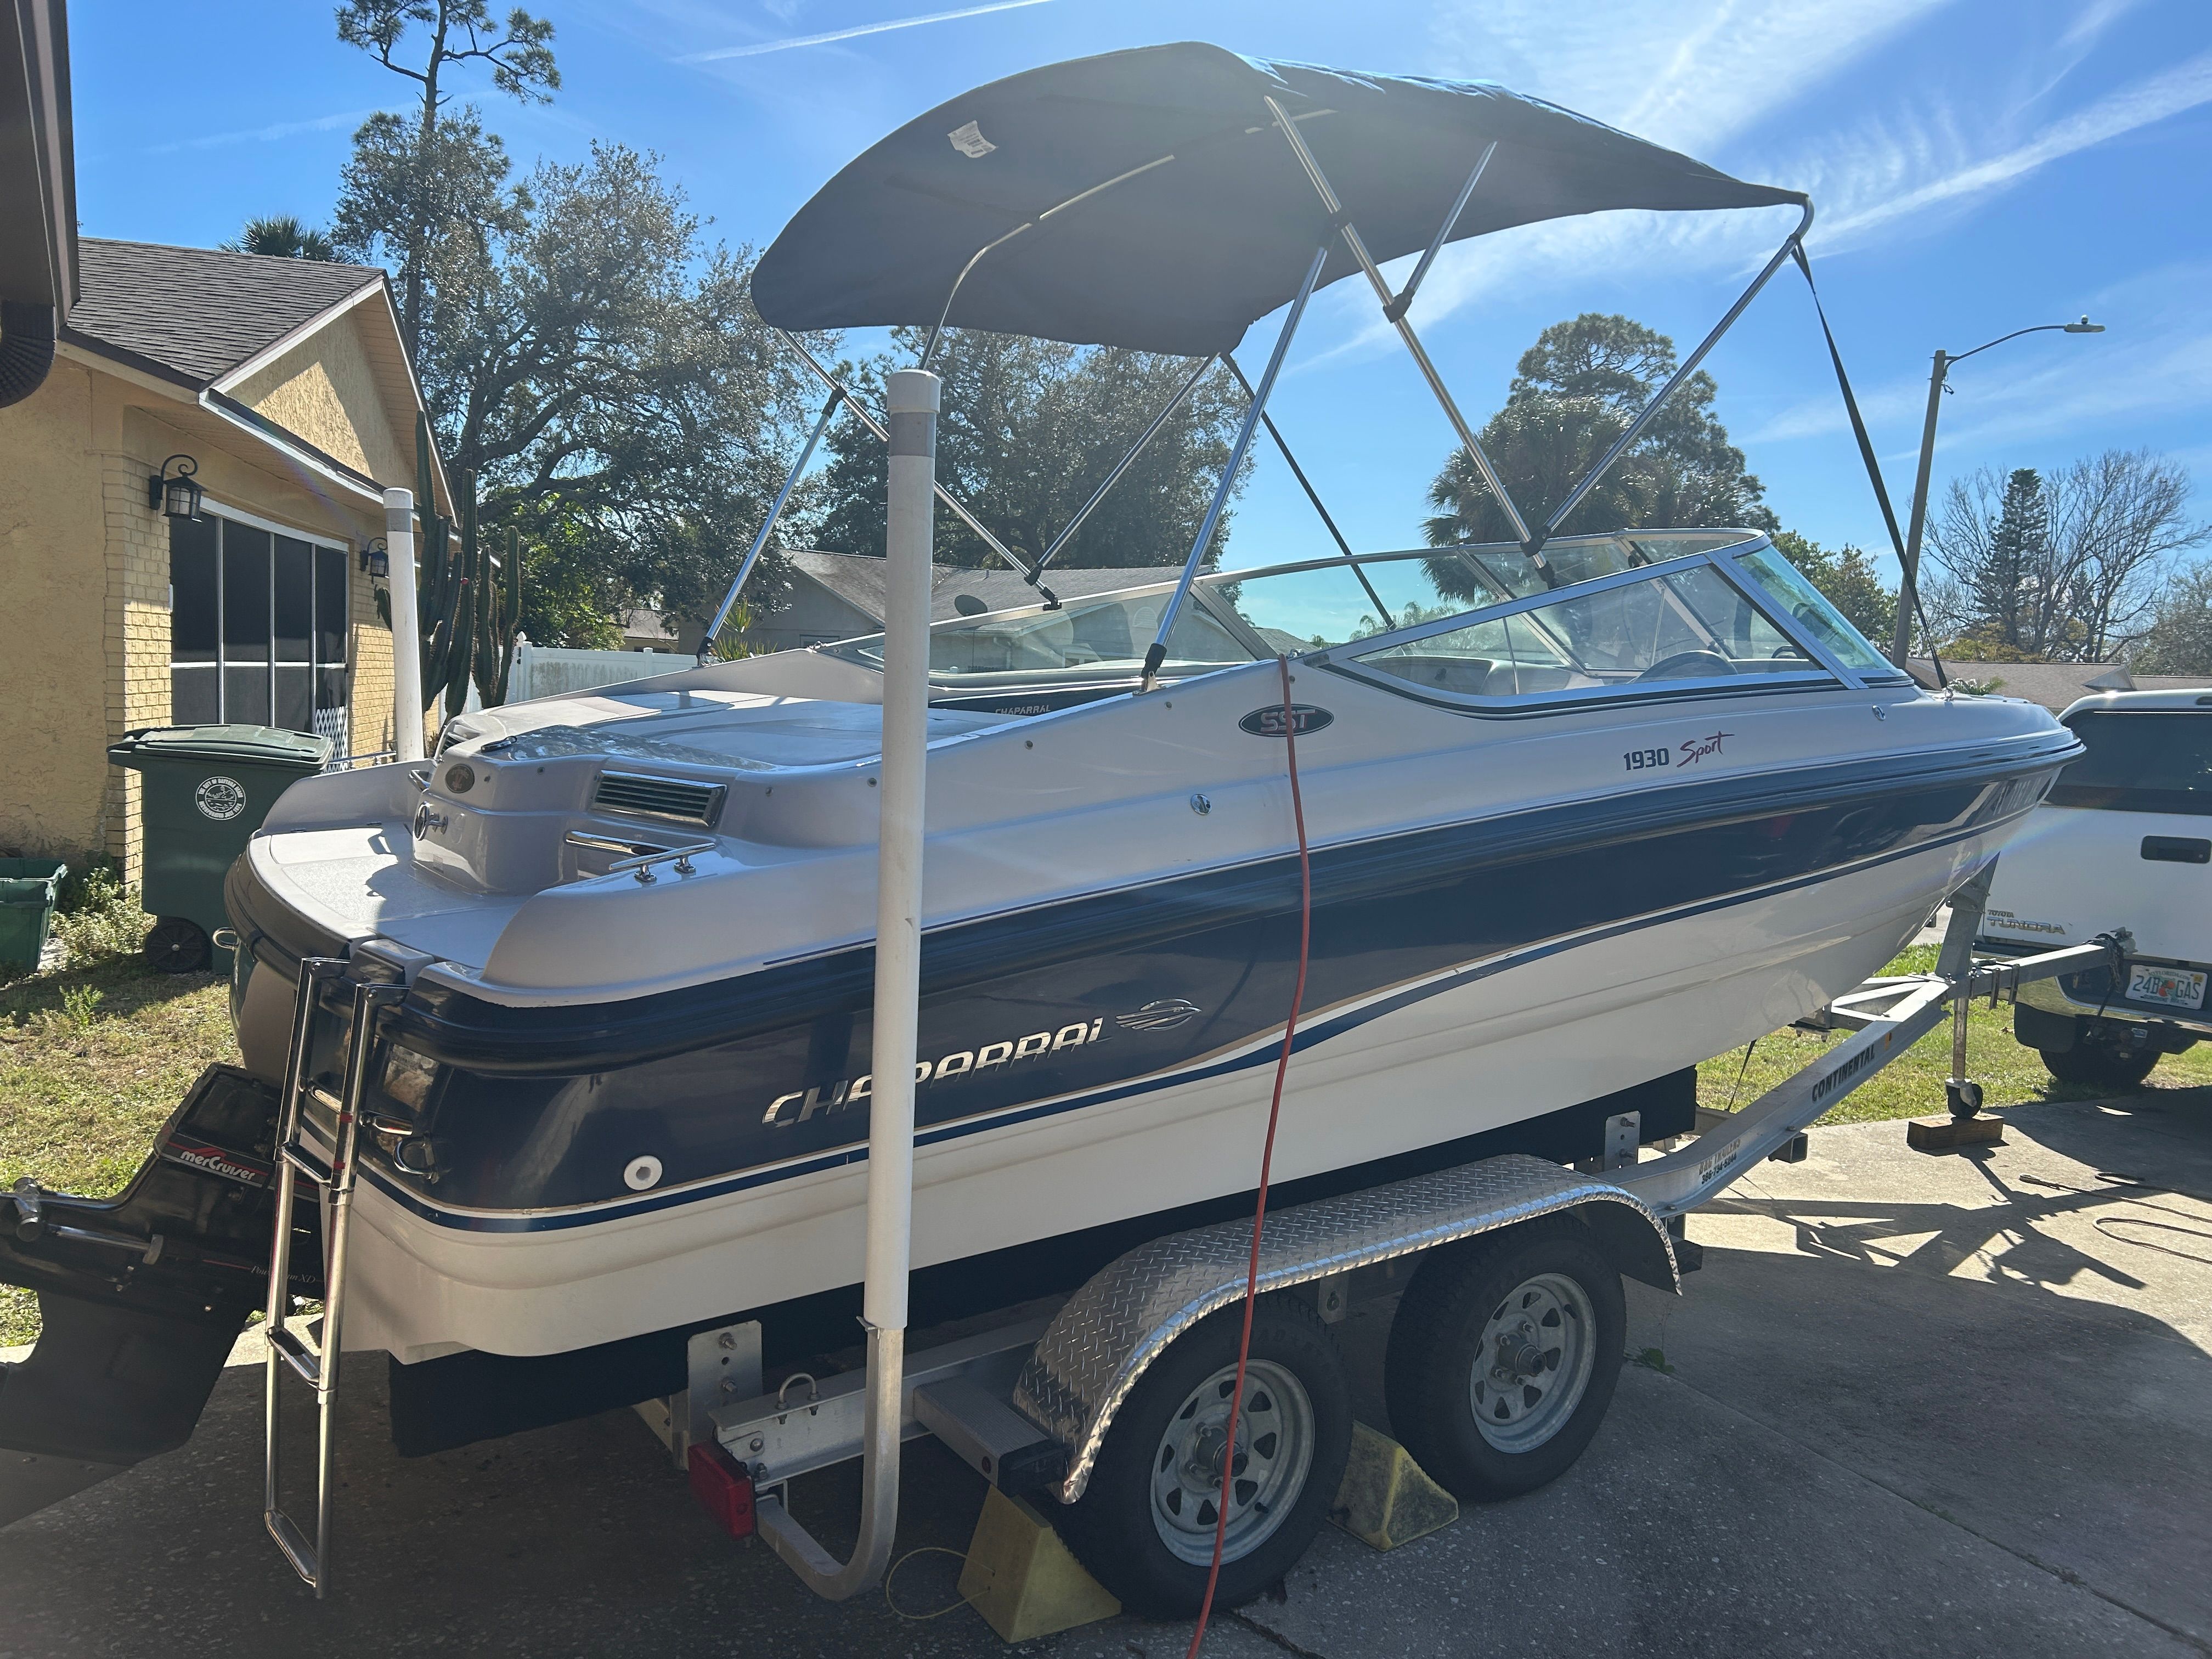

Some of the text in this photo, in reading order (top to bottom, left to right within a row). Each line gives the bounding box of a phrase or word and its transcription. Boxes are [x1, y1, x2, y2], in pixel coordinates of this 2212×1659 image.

[1260, 709, 1316, 733] SST
[1623, 730, 1735, 771] 1930 Sport
[1987, 909, 2015, 918] TOYOTA
[1987, 916, 2066, 935] TUNDRA
[2132, 975, 2201, 1000] 24B GAS
[1812, 1044, 1875, 1102] CONTINENTAL
